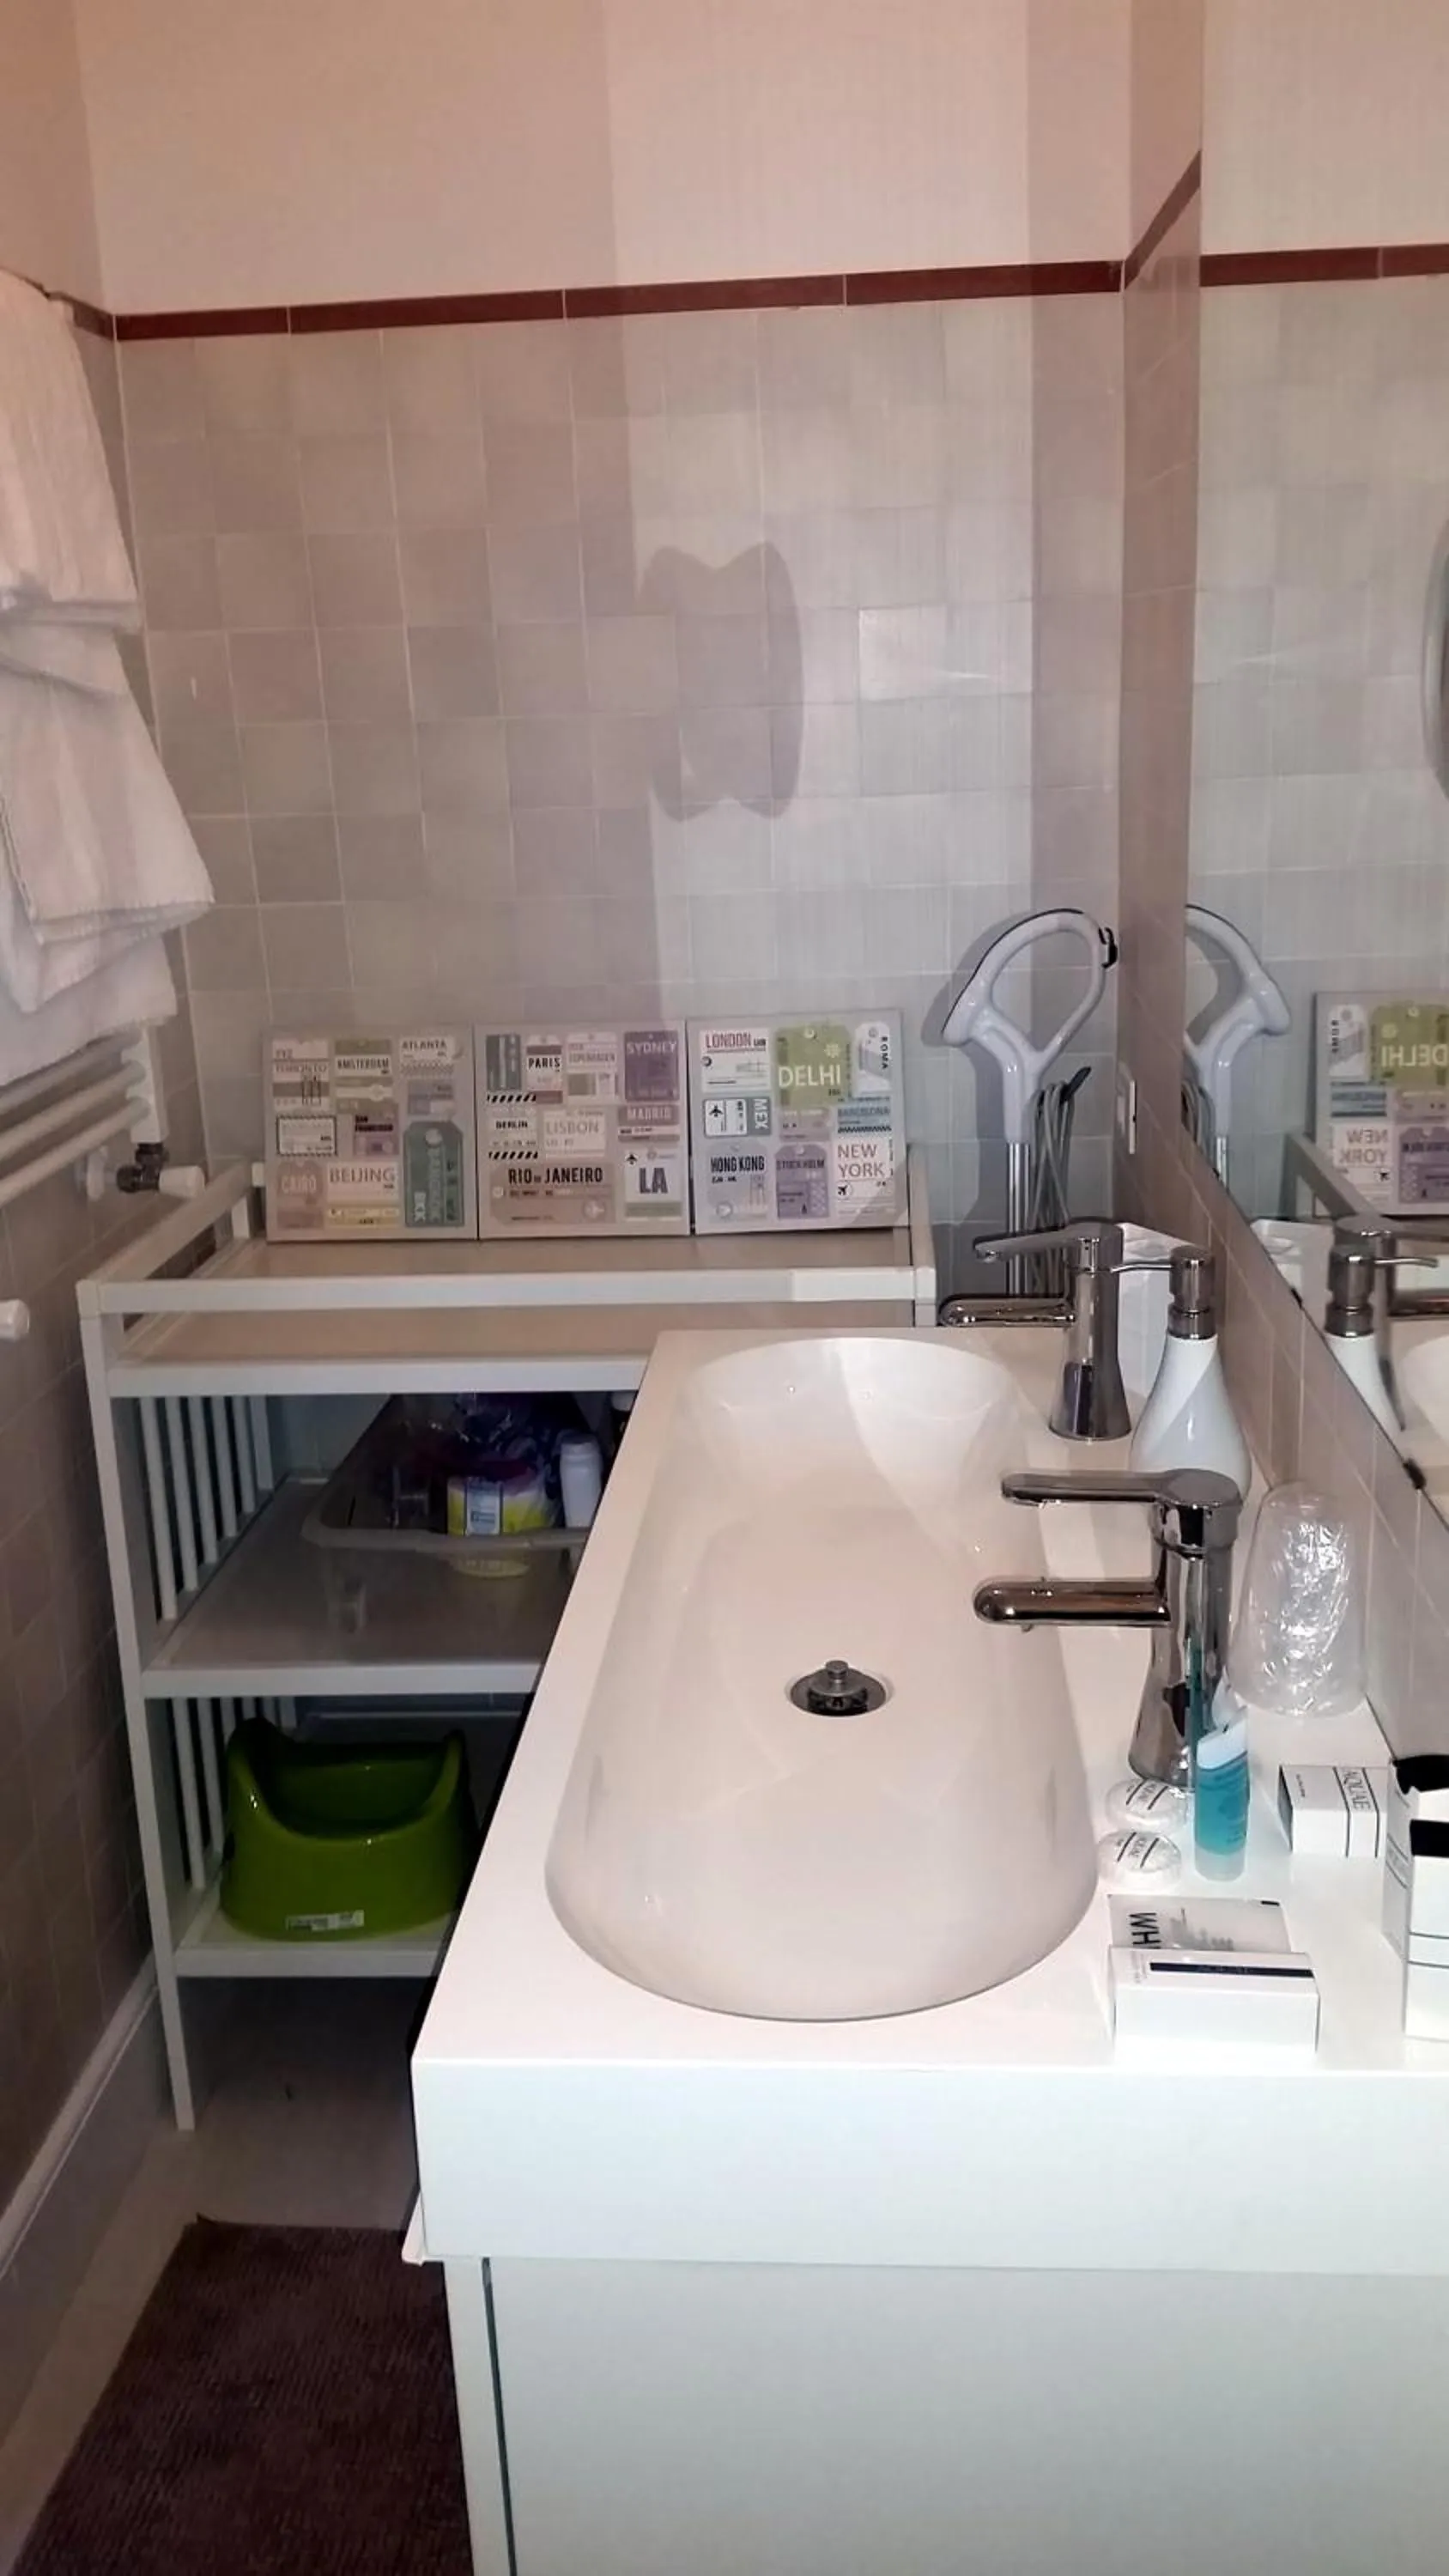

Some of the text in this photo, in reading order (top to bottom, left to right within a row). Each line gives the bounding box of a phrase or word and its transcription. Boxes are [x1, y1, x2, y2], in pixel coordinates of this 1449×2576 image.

[401, 1039, 447, 1050] ATLANTA
[627, 1041, 677, 1055] SYDNEY
[705, 1033, 752, 1049] LONDON
[880, 1036, 890, 1070] ROMA
[336, 1057, 390, 1071] AMSTERDAM
[527, 1057, 561, 1069] PARIS
[778, 1063, 842, 1088] DELHI
[626, 1106, 671, 1121] MADRID
[495, 1120, 529, 1130] BERLIN
[545, 1120, 600, 1136] LISBON
[837, 1143, 878, 1159] NEW
[710, 1155, 766, 1174] HONG KONG
[838, 1163, 887, 1180] YORK
[329, 1166, 397, 1184] BEIJING
[508, 1168, 533, 1184] RIO
[544, 1166, 604, 1183] JANEIRO
[639, 1166, 669, 1194] LA
